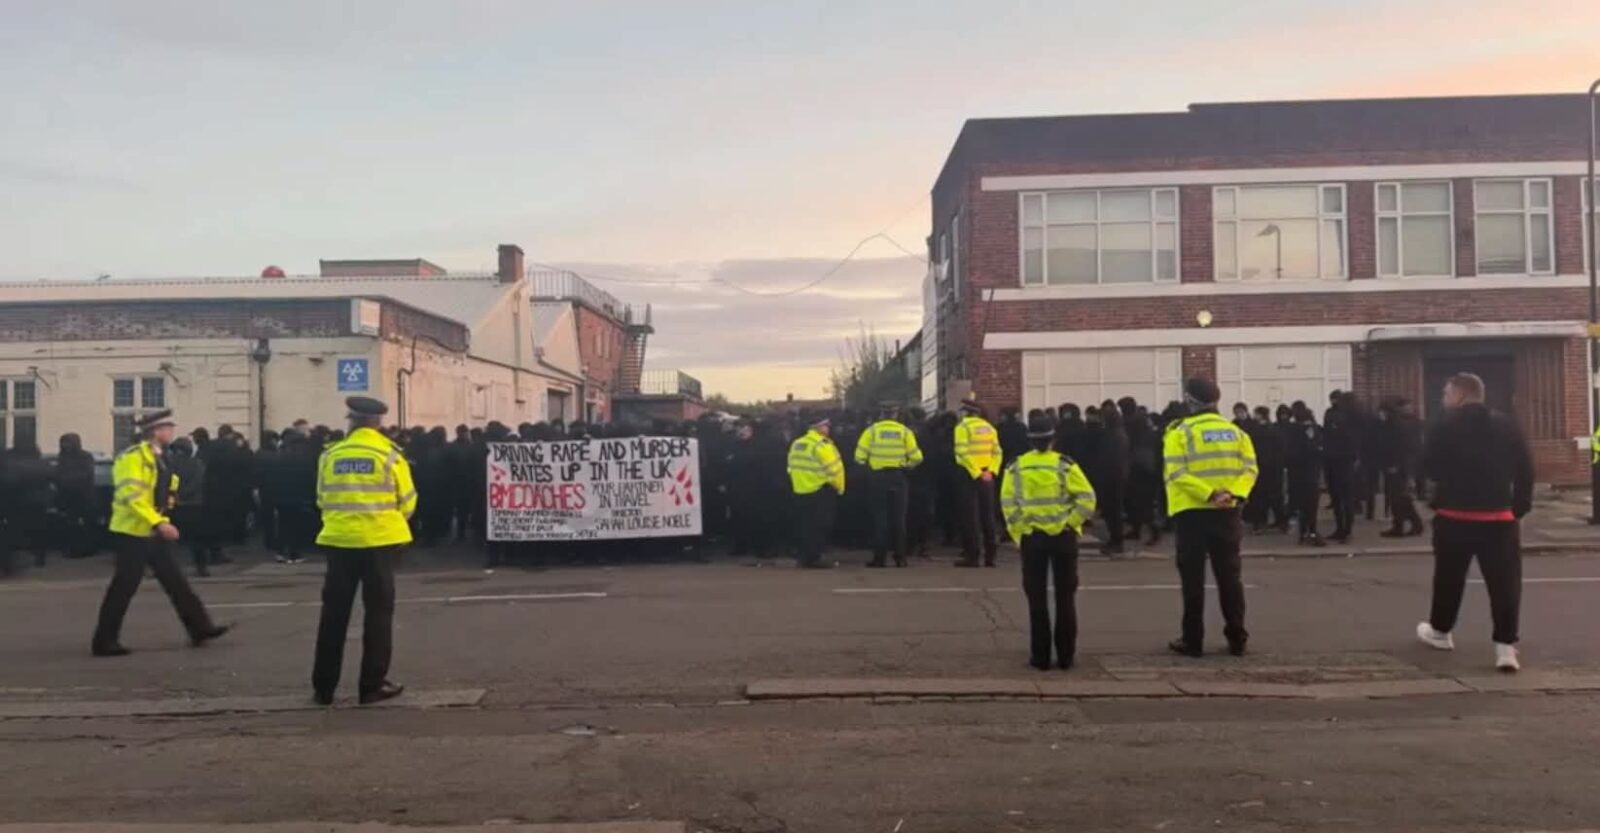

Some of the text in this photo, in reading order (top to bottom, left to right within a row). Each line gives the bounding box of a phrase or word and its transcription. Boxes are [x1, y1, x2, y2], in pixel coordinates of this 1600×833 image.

[1204, 431, 1237, 441] POLICE
[493, 438, 691, 463] DRIVING RAPE AND MURDER
[335, 461, 373, 473] POLICE
[510, 459, 673, 482] RATES UP IN THE UK
[591, 481, 665, 495] YOUR PARTNER
[599, 494, 651, 508] IN TRAVEL
[627, 515, 661, 530] LOUISE
[663, 514, 691, 527] NOBLE
